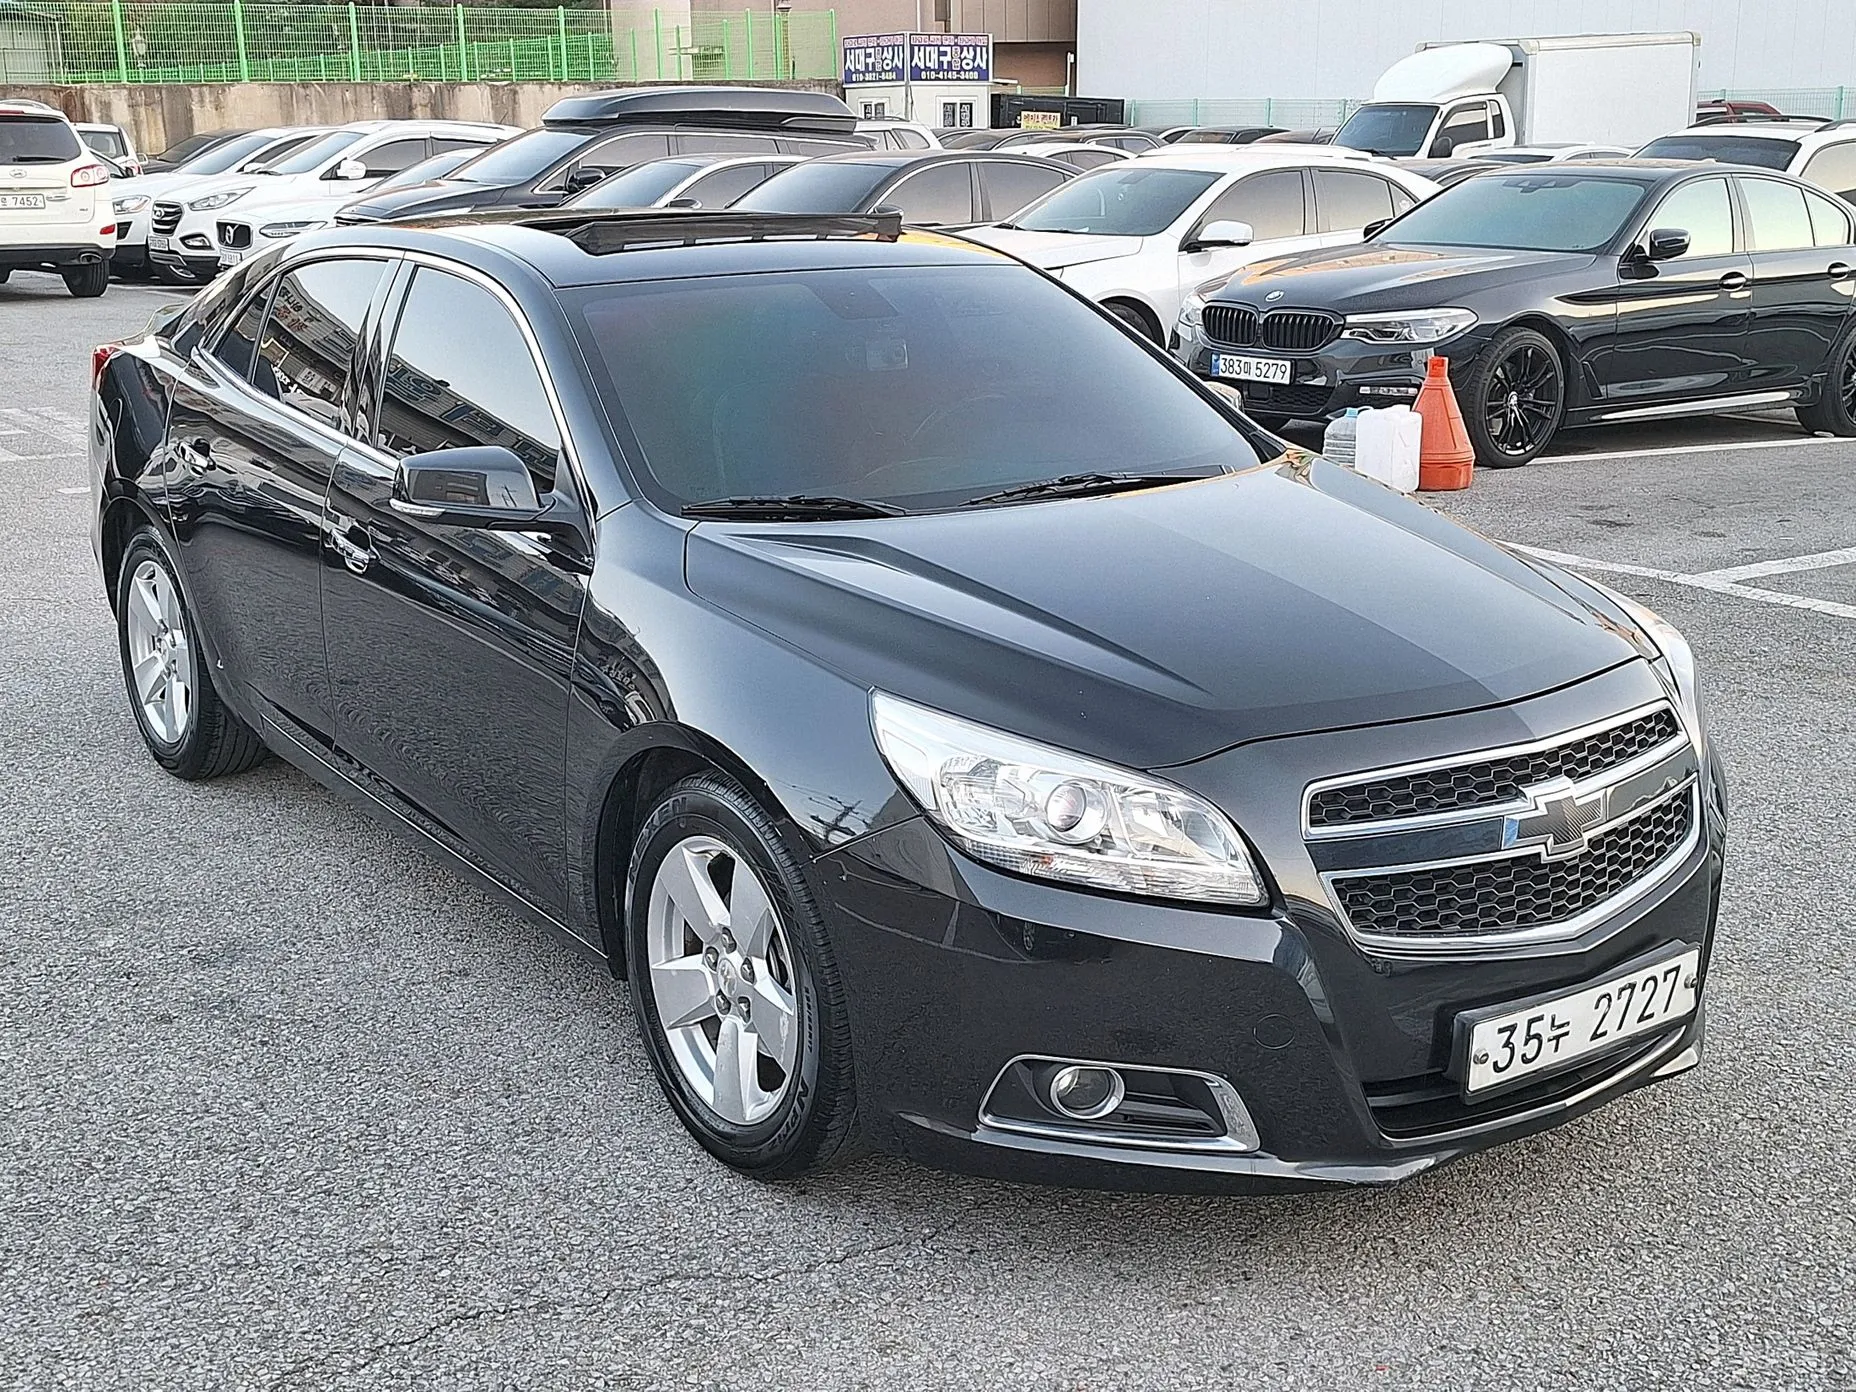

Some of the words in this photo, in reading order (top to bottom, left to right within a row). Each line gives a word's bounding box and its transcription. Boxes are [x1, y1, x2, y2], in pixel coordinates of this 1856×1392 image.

[12, 196, 39, 207] 7452
[1220, 357, 1252, 376] 383마
[1255, 361, 1288, 380] 5279
[1492, 1013, 1571, 1074] 35누
[1589, 964, 1682, 1042] 2727
